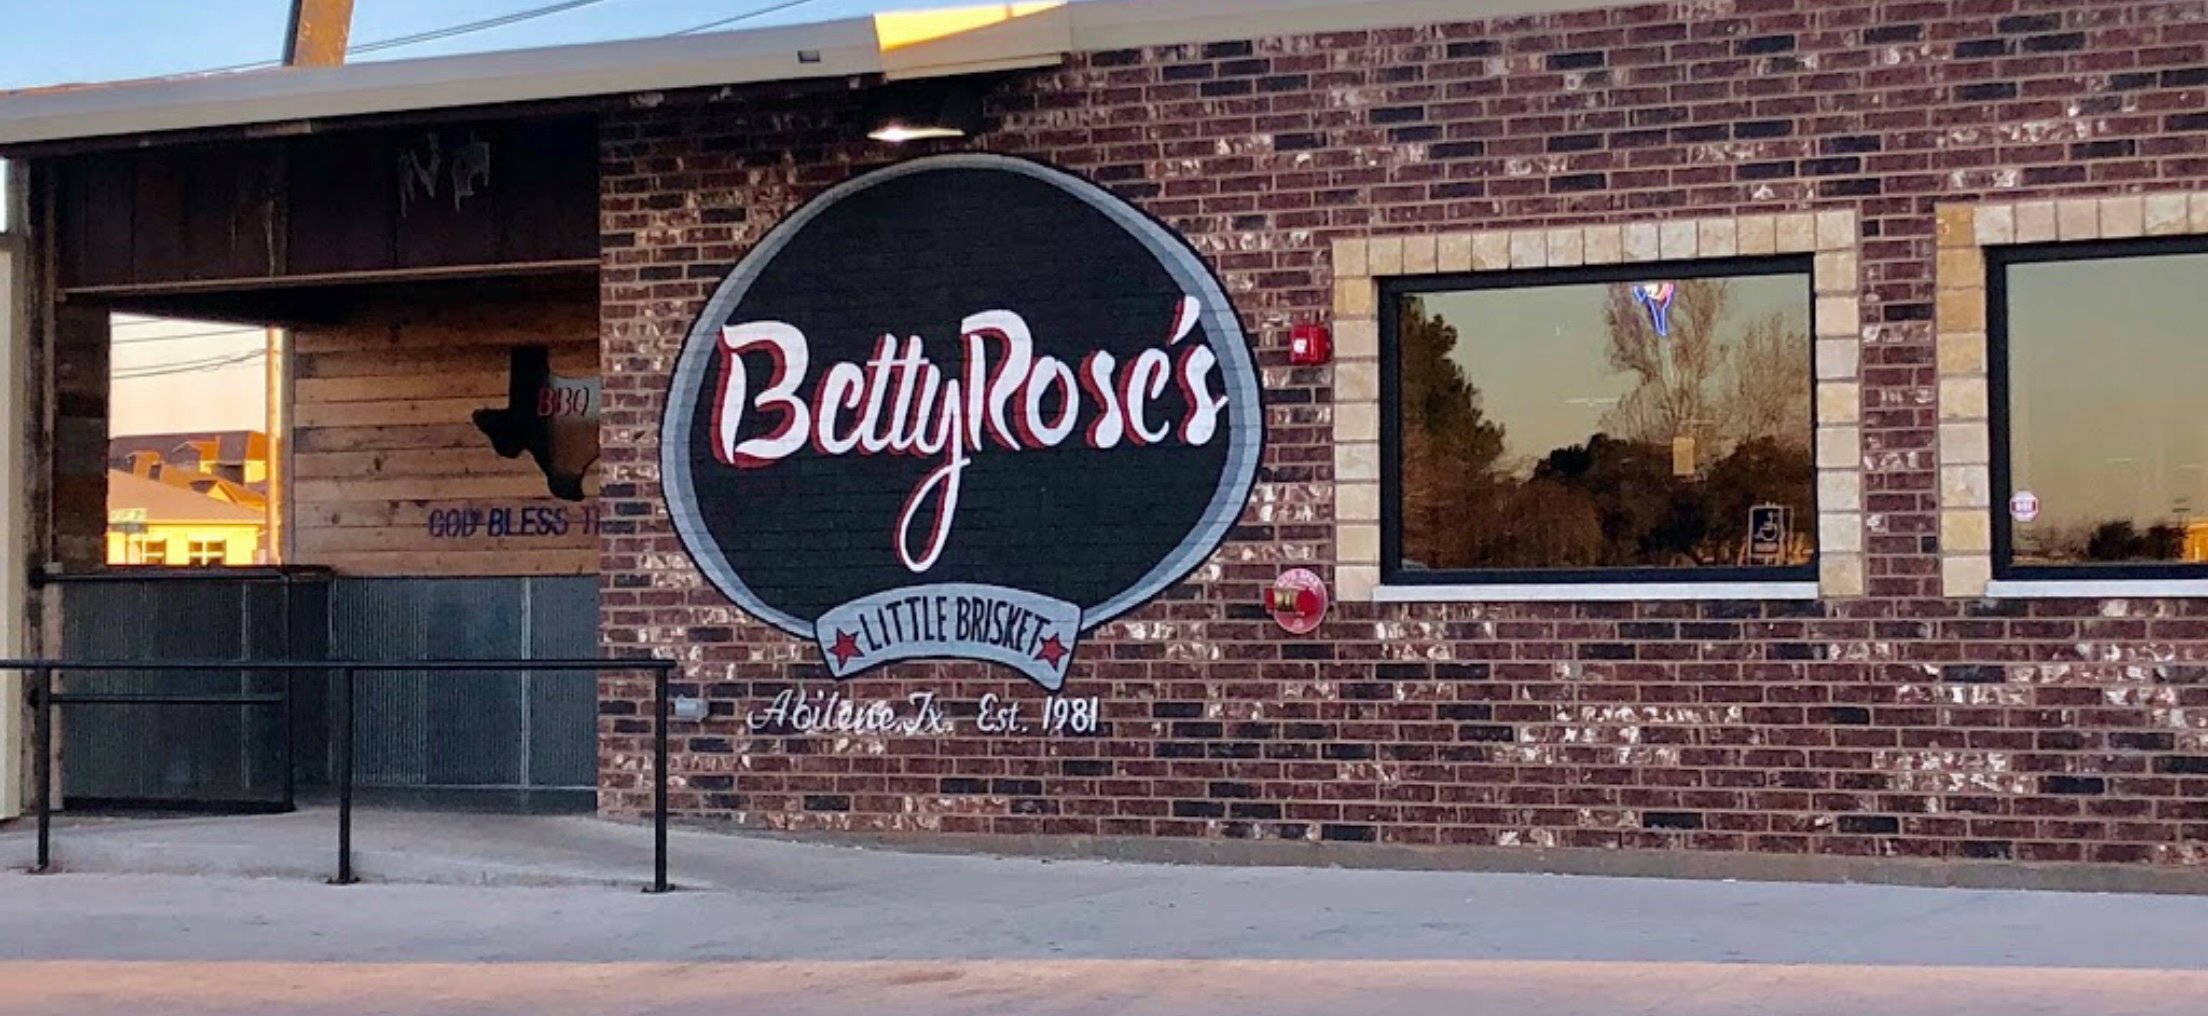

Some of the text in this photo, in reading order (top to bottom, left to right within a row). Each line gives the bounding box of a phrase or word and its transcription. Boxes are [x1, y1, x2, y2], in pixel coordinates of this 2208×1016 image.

[537, 386, 590, 417] BBQ
[428, 507, 480, 537] GOD
[487, 506, 570, 537] BLESS
[859, 596, 1052, 656] LITTLE BRISKET
[976, 692, 1029, 733] Est.
[1042, 695, 1099, 733] 1981
